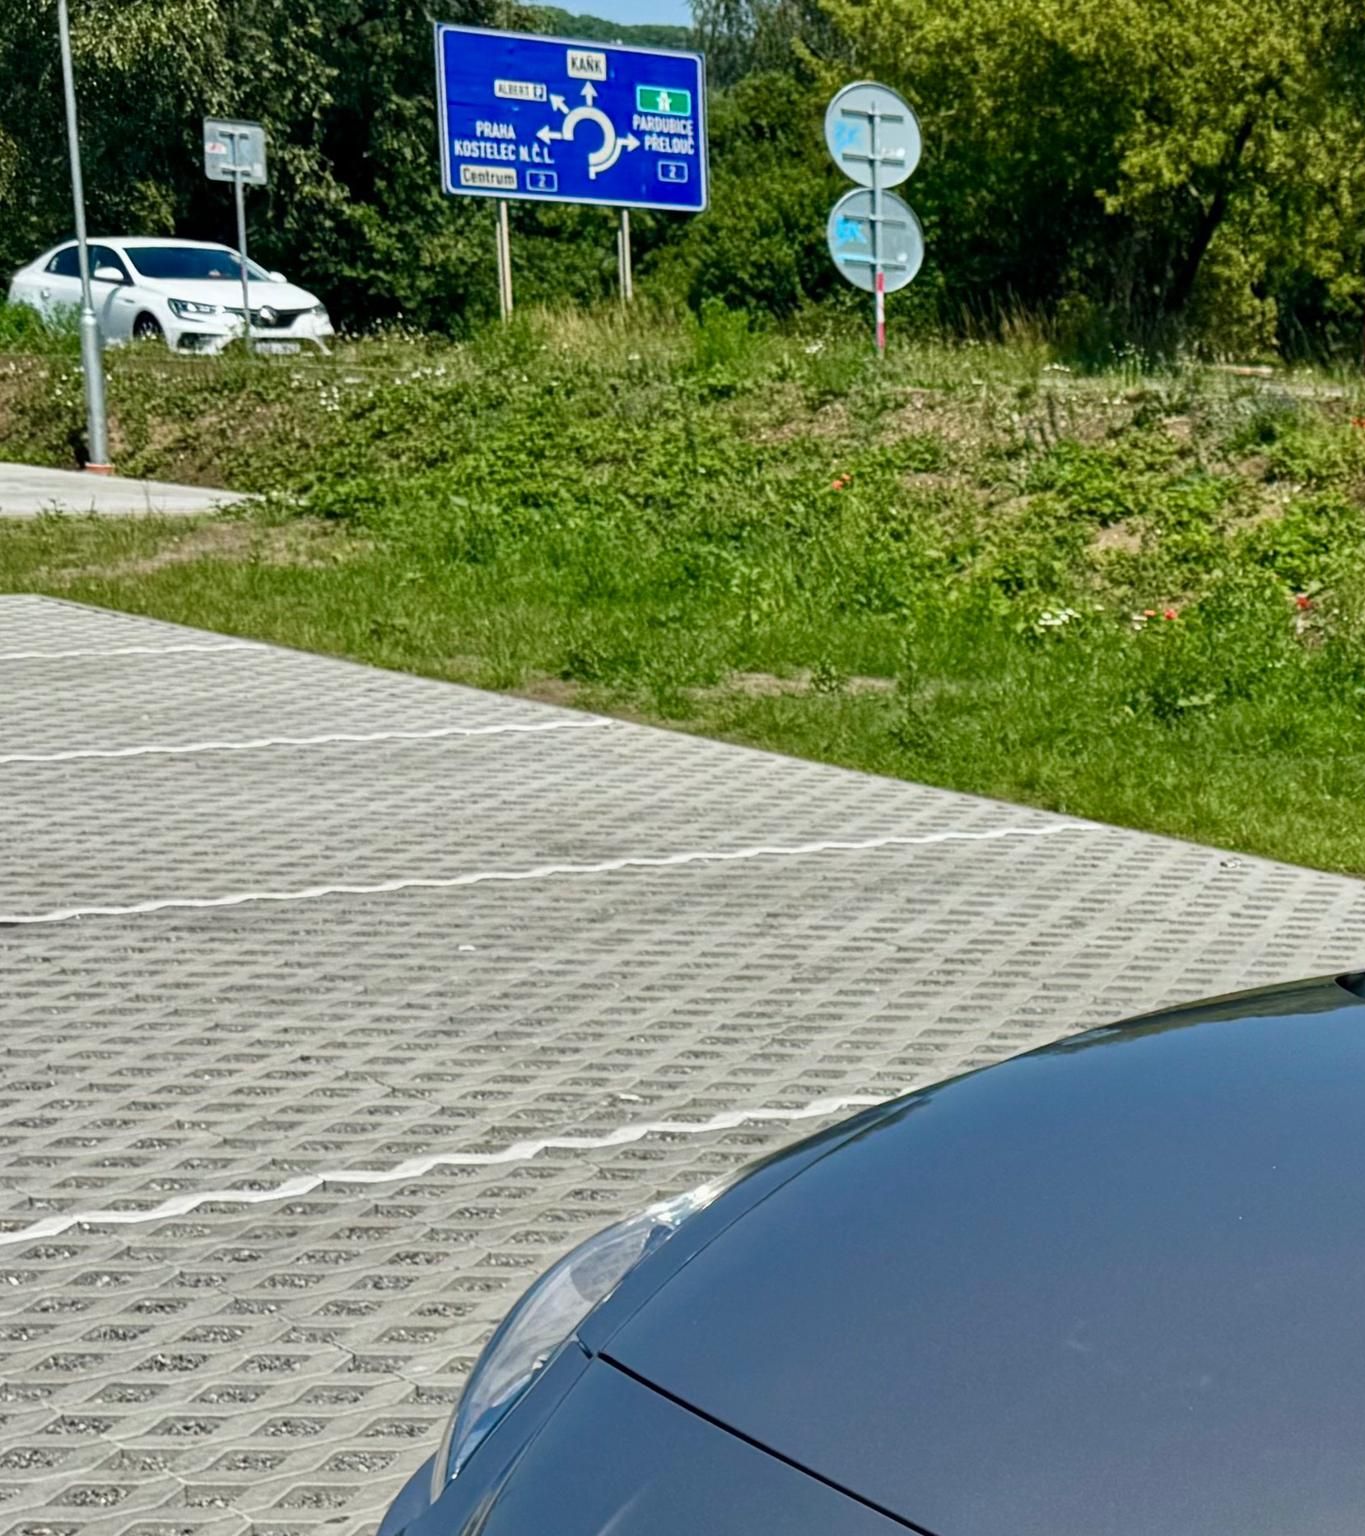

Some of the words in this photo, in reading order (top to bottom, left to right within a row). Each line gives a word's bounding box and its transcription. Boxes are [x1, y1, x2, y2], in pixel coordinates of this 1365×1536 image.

[571, 56, 602, 74] KAŇK
[476, 120, 516, 139] PRAHA
[633, 114, 694, 135] PARDUBICE
[454, 140, 516, 160] KOSTELEC
[463, 167, 515, 185] Centrum
[538, 174, 546, 188] 2
[669, 165, 676, 179] 2
